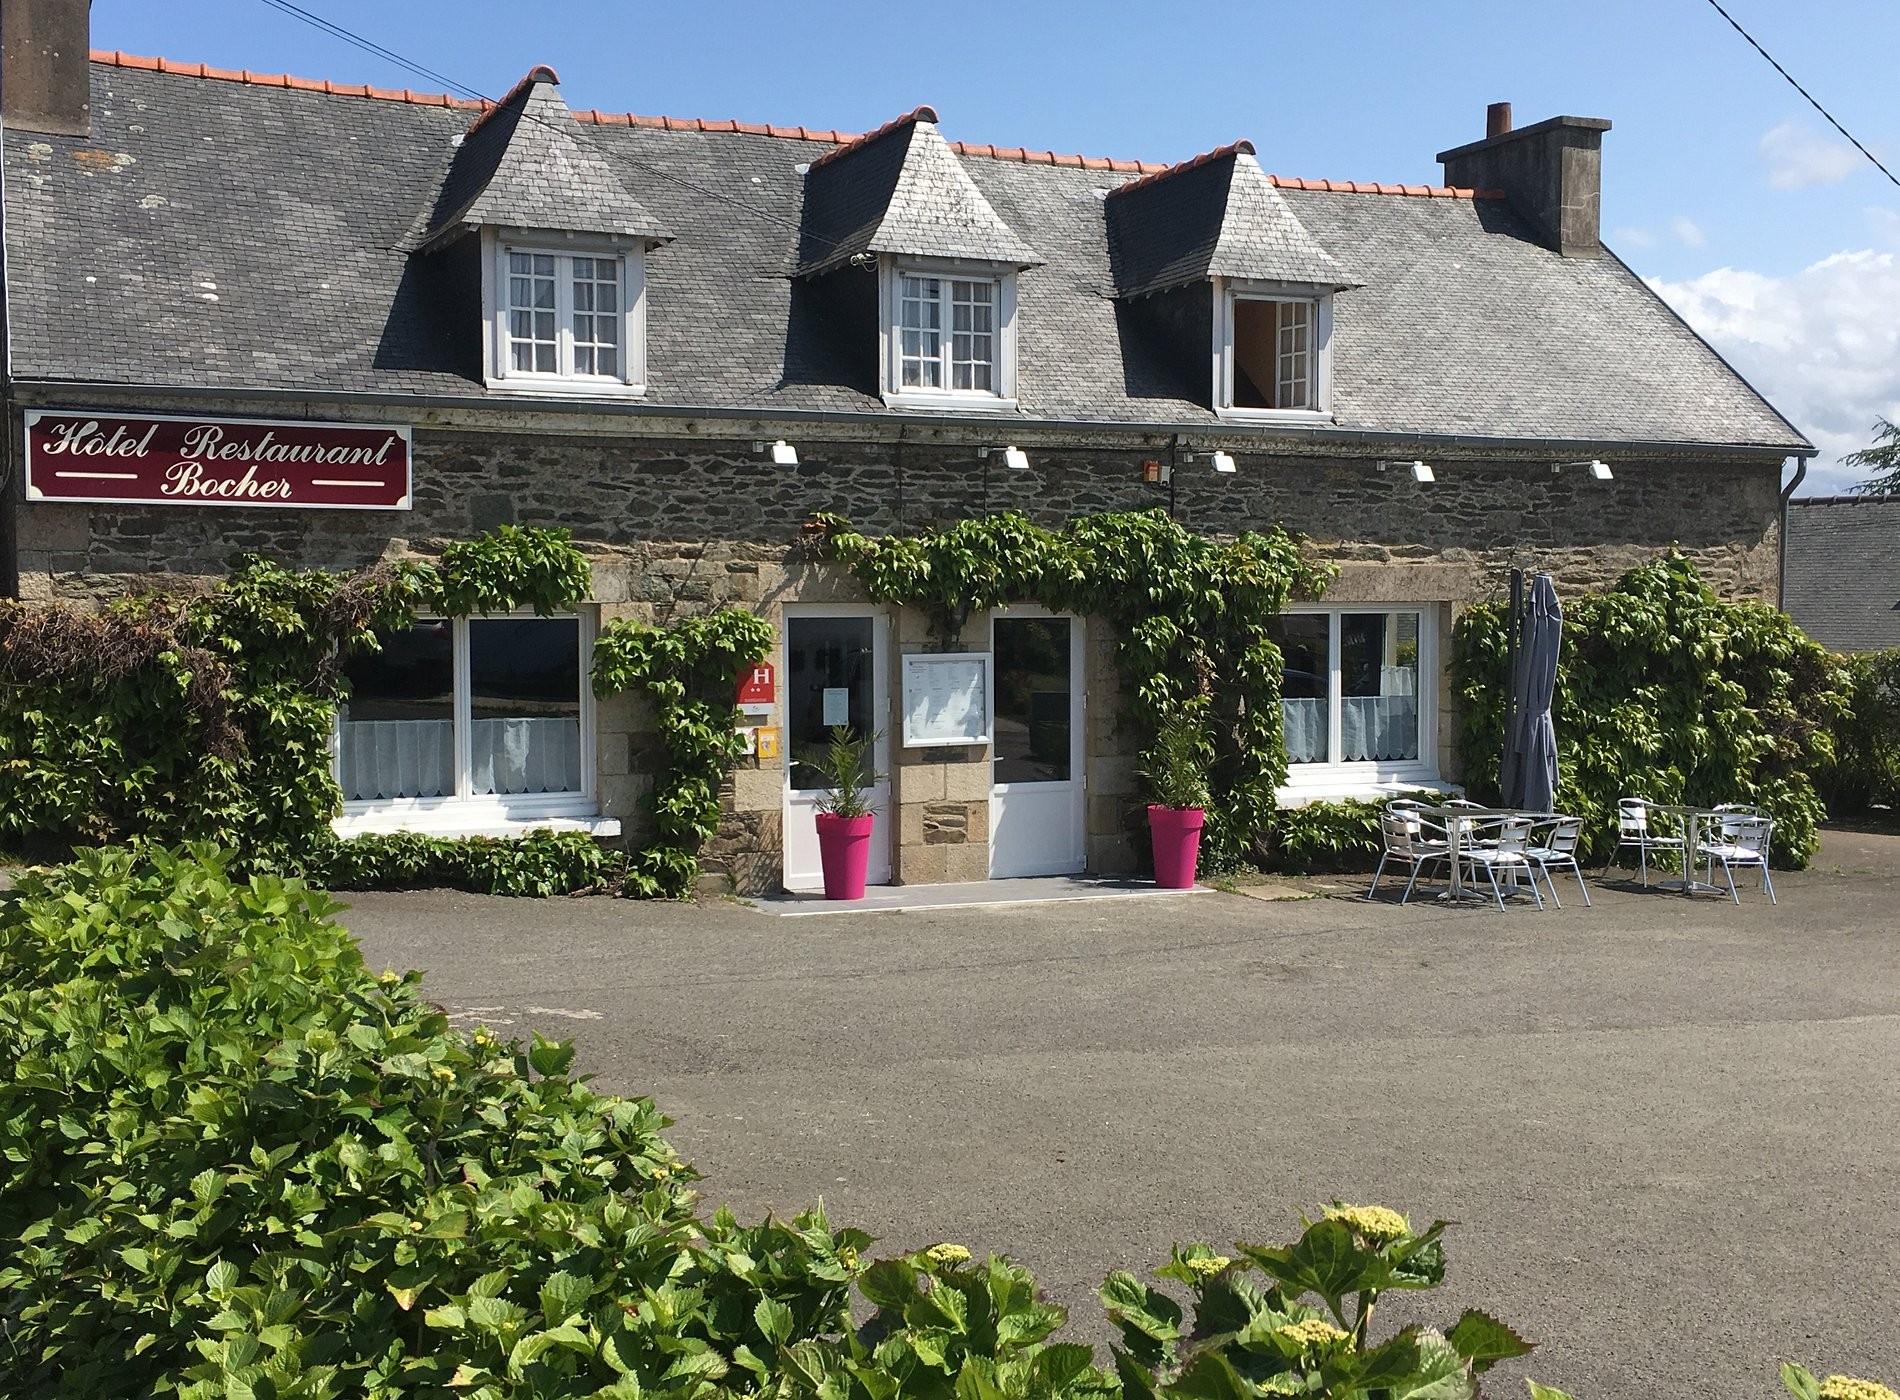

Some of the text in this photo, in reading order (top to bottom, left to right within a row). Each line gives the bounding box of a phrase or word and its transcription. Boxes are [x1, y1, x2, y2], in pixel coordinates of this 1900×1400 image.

[42, 421, 395, 465] Hôtel Restaurant
[160, 461, 292, 498] Bocher
[753, 668, 770, 685] H
